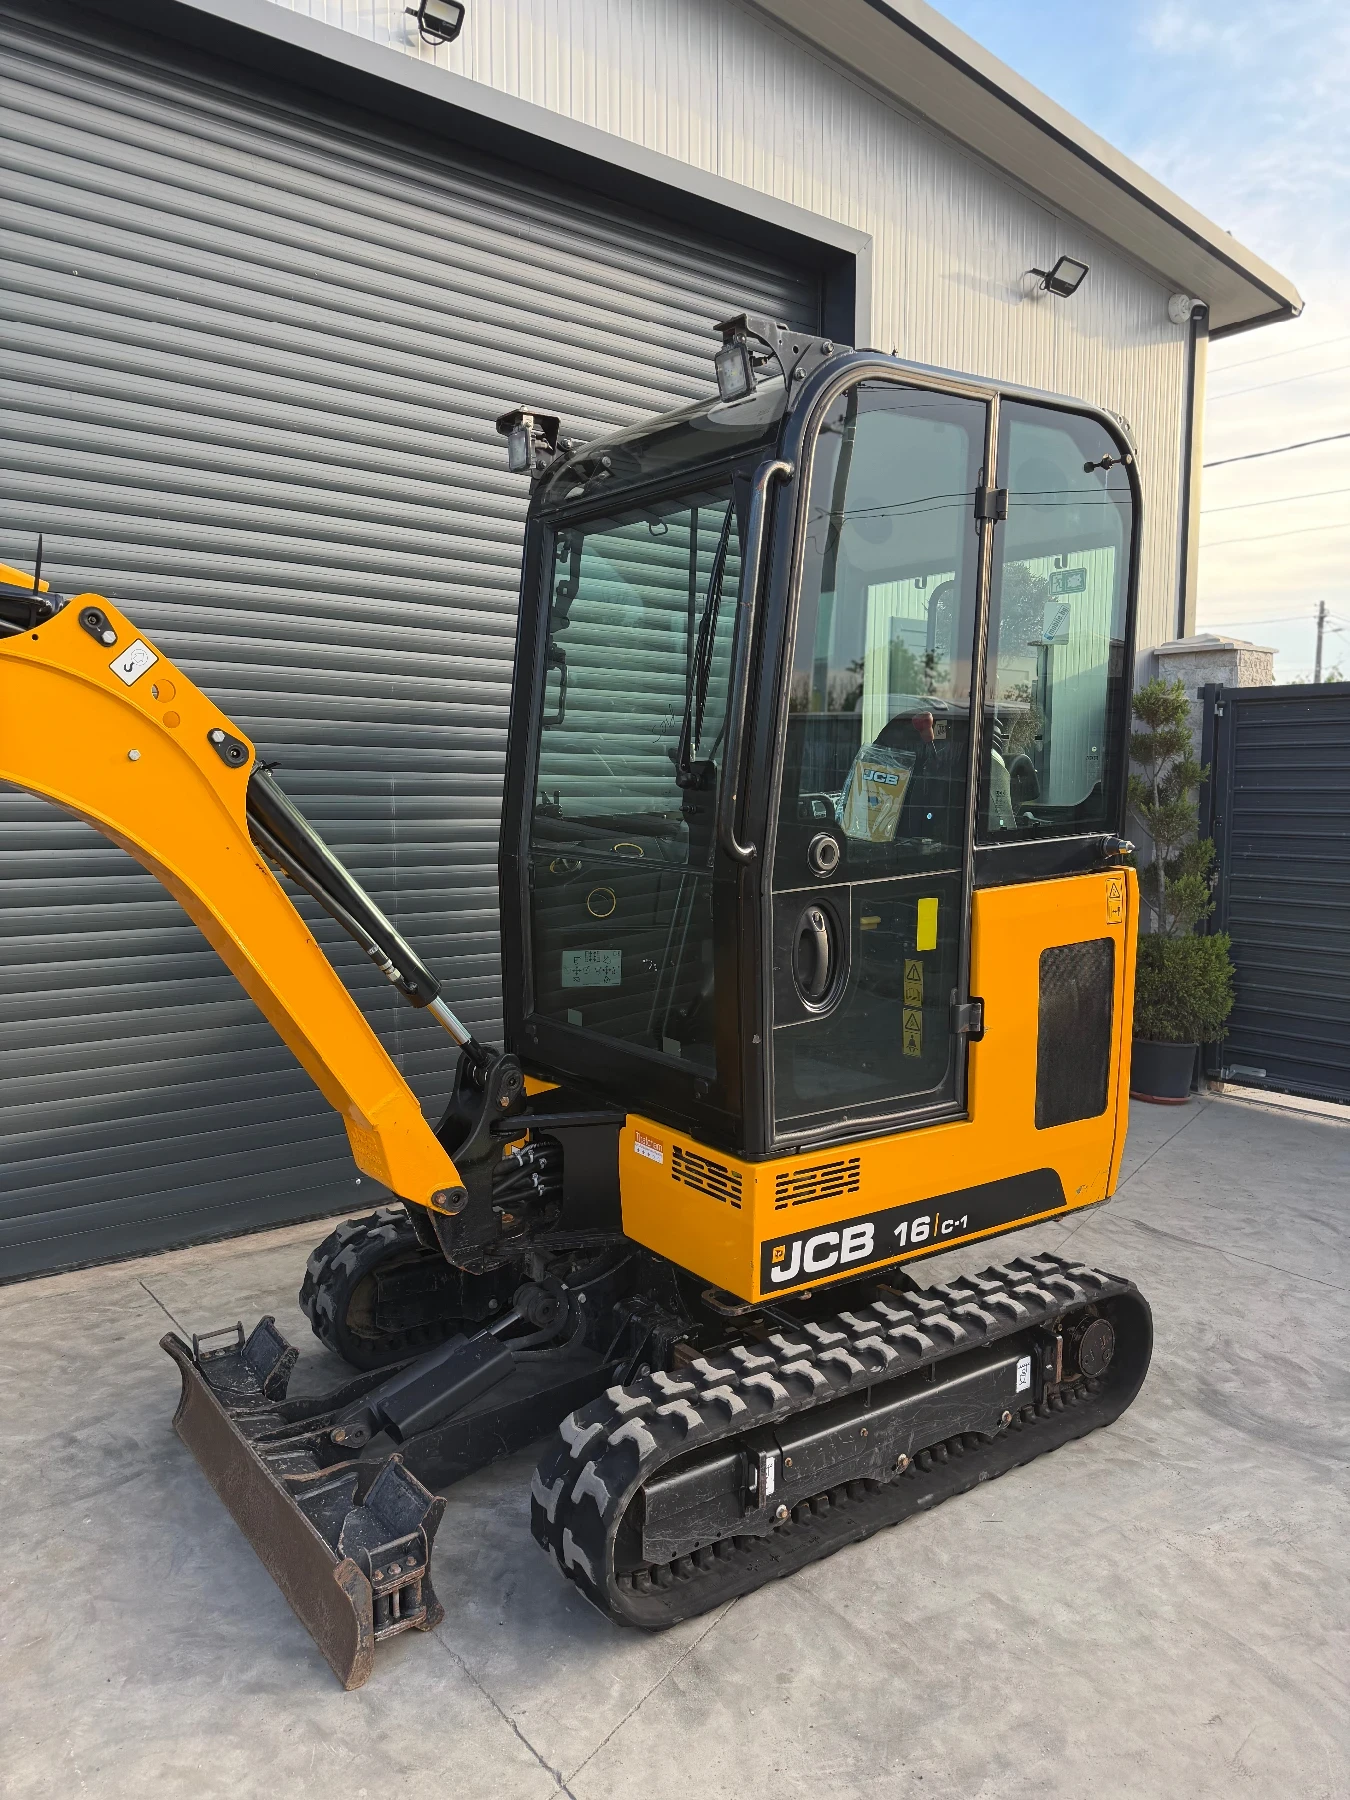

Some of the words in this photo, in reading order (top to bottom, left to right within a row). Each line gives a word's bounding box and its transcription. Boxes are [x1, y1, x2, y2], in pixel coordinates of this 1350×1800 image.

[1048, 606, 1069, 635] mobile.bg
[863, 769, 899, 785] JCB
[771, 1222, 875, 1283] JCB
[893, 1215, 931, 1247] 16
